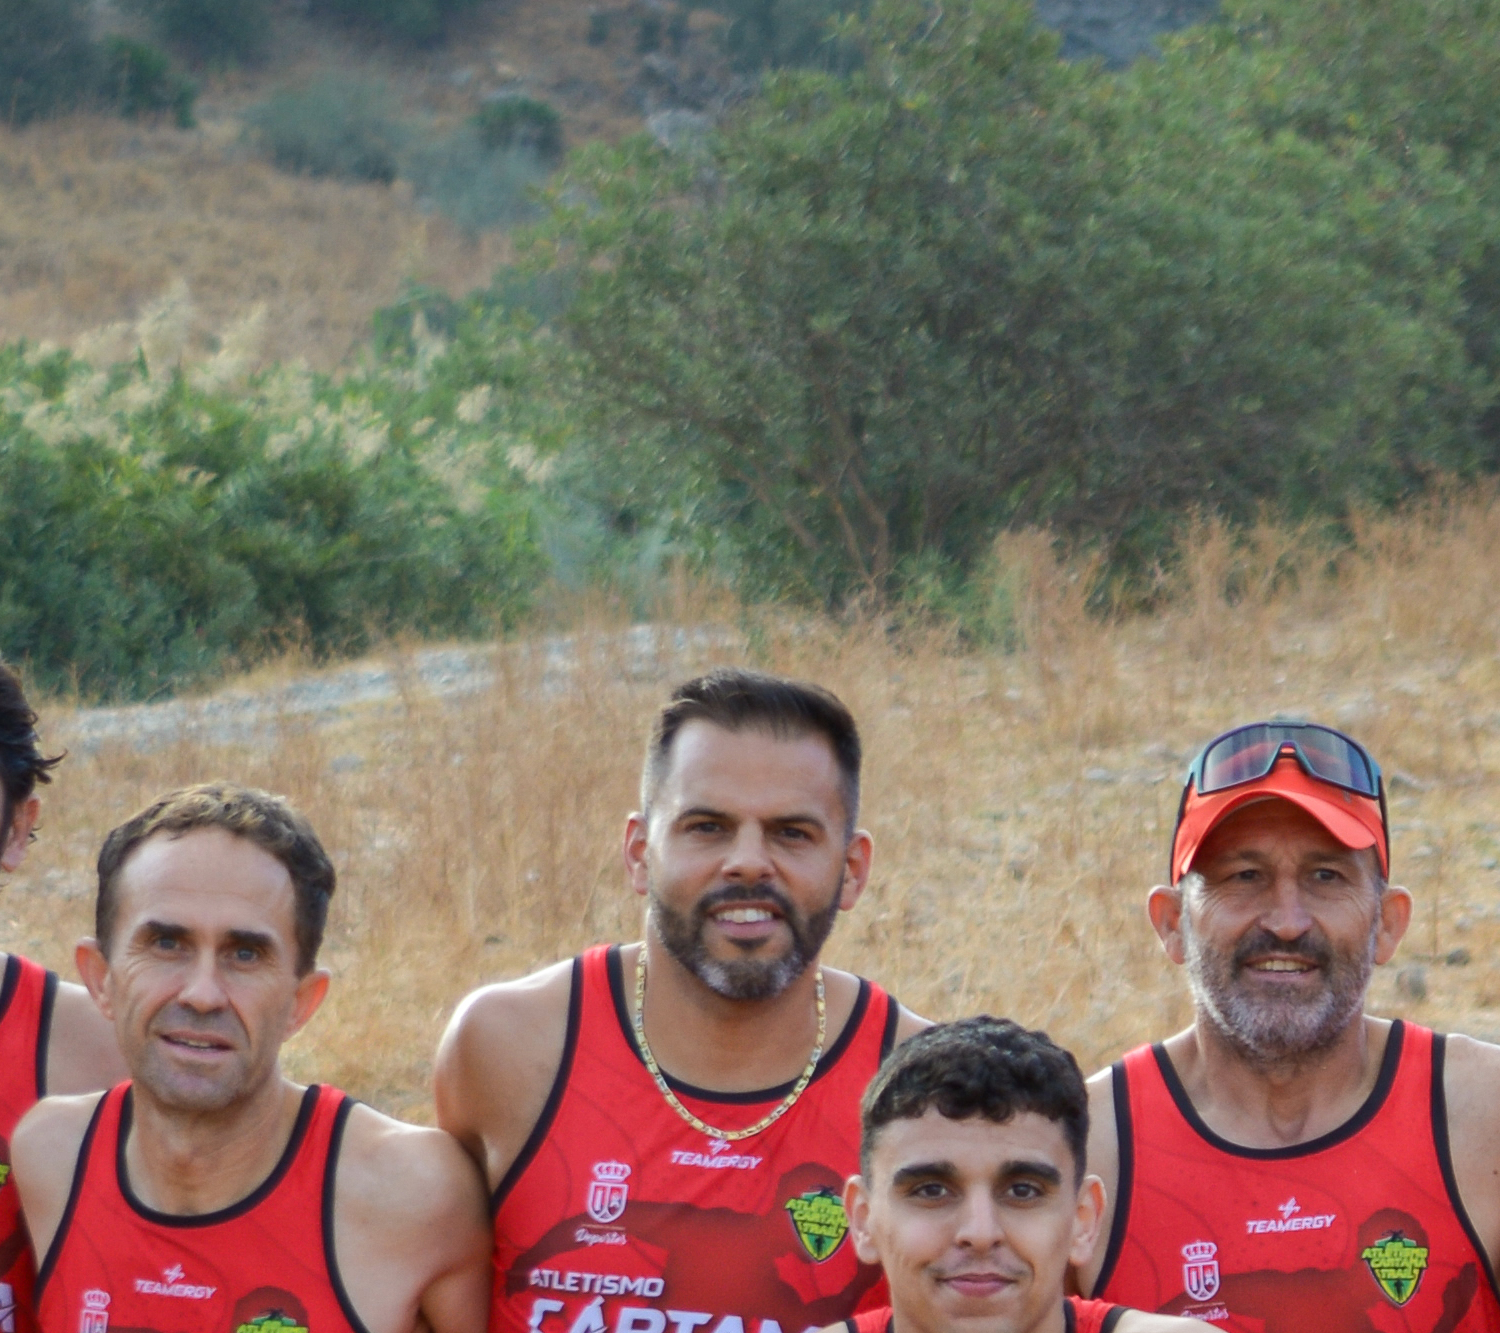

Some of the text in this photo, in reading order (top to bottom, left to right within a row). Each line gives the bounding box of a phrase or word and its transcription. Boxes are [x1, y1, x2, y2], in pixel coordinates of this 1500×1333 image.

[670, 1151, 763, 1170] TEAMERGY
[1246, 1214, 1336, 1235] TEAMERGY
[574, 1227, 628, 1245] Deportes
[135, 1278, 217, 1300] TEAMERGY
[528, 1268, 665, 1298] ATLETISMO
